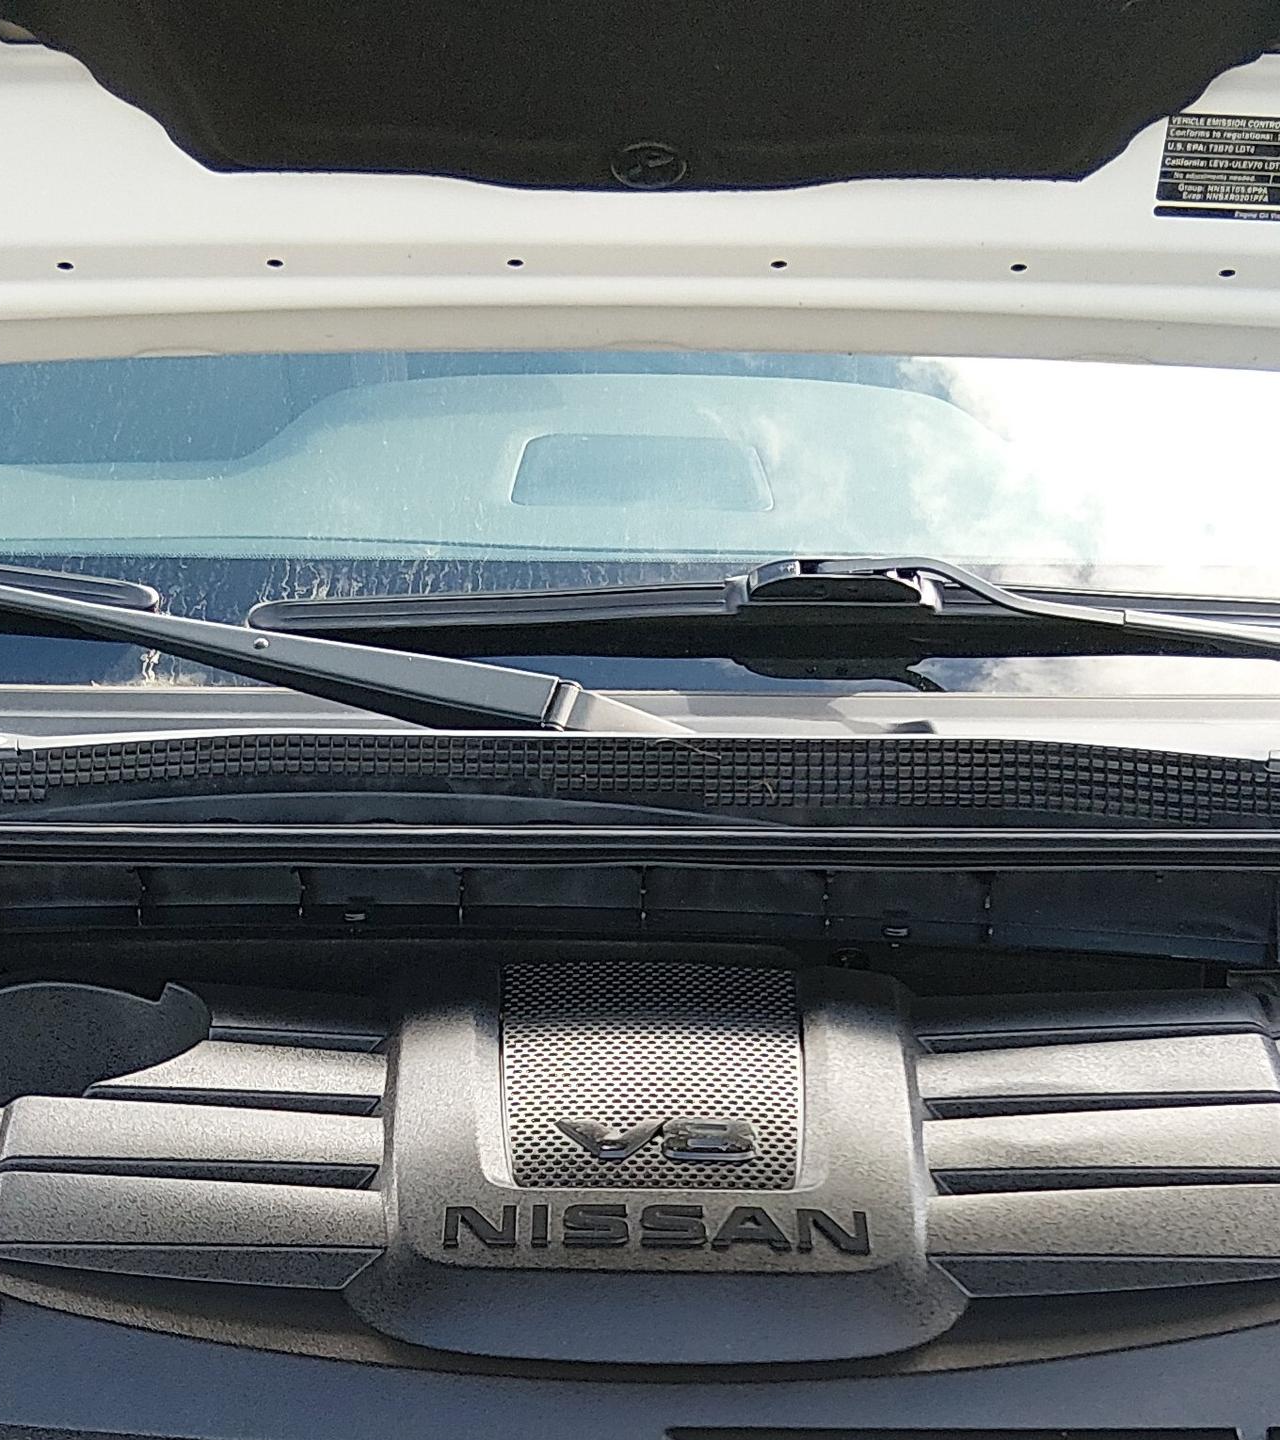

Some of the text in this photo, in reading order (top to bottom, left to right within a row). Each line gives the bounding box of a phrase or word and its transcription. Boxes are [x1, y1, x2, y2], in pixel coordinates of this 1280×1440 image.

[1172, 116, 1205, 126] VEHICLE
[1206, 117, 1247, 128] EMISSION
[1169, 128, 1211, 138] Conforms
[1212, 130, 1222, 138] to
[1223, 130, 1273, 141] regulations:
[1167, 142, 1184, 151] U.S.
[1186, 143, 1206, 152] EPA:
[1165, 157, 1208, 167] California:
[1177, 183, 1205, 193] Group:
[1182, 191, 1204, 200] Evap:
[554, 1117, 758, 1161] V8
[442, 1203, 871, 1255] NISSAN
